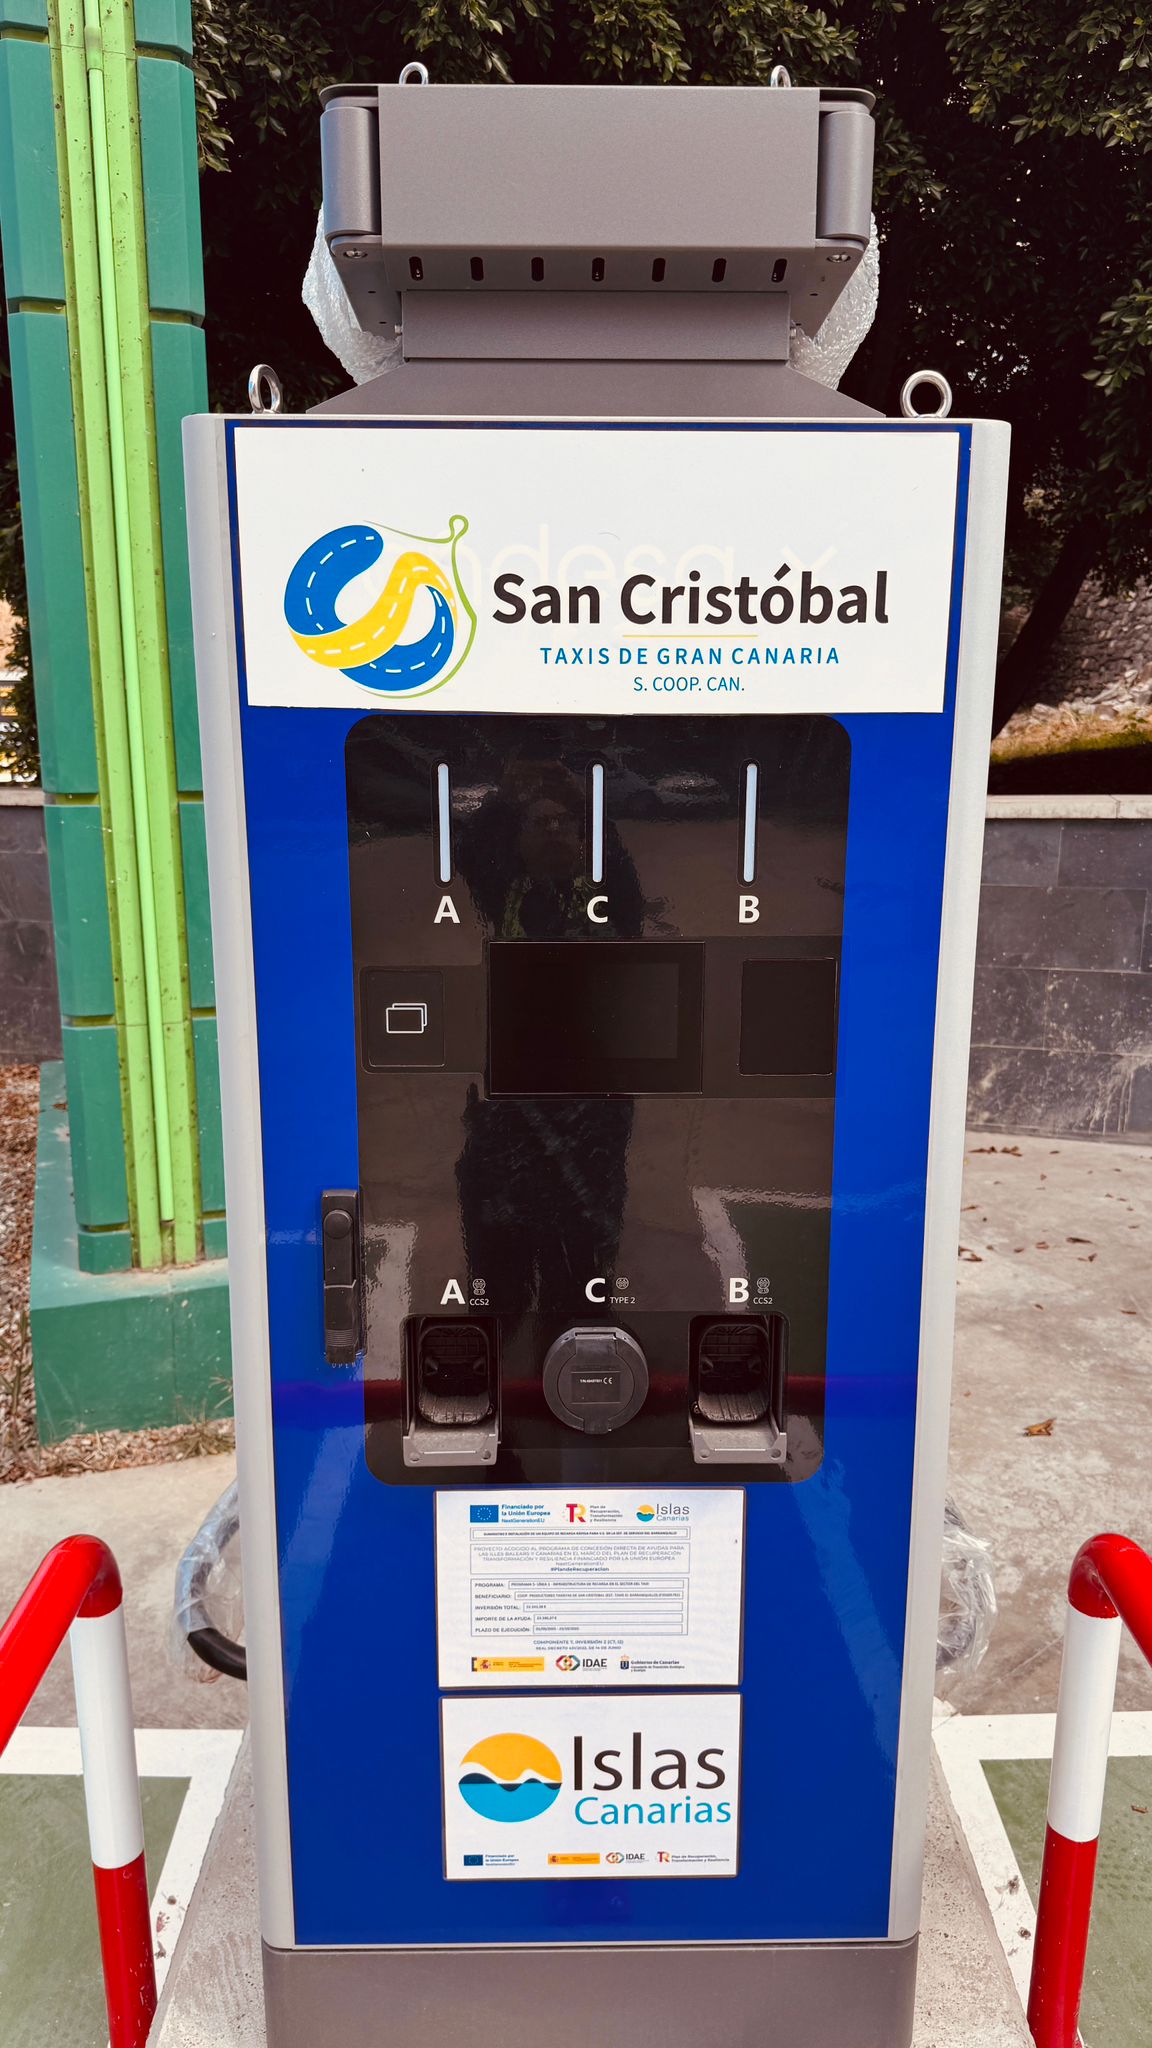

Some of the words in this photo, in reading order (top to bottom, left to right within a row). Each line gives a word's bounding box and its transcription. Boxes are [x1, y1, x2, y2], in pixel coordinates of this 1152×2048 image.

[492, 573, 600, 624] San
[620, 563, 888, 625] Cristóbal
[540, 647, 610, 664] TAXIS
[620, 647, 648, 664] DE
[657, 647, 722, 664] GRAN
[731, 647, 839, 664] CANARIA
[634, 677, 647, 691] S.
[653, 677, 702, 691] COOP.
[707, 677, 744, 691] CAN.
[434, 896, 460, 923] A
[586, 896, 608, 924] C
[738, 895, 760, 923] B
[440, 1279, 465, 1304] A
[585, 1278, 605, 1302] C
[730, 1278, 749, 1302] B
[656, 1504, 690, 1515] Islas
[582, 1658, 607, 1667] IDAE
[574, 1732, 726, 1791] Islas
[574, 1796, 731, 1825] Canarias
